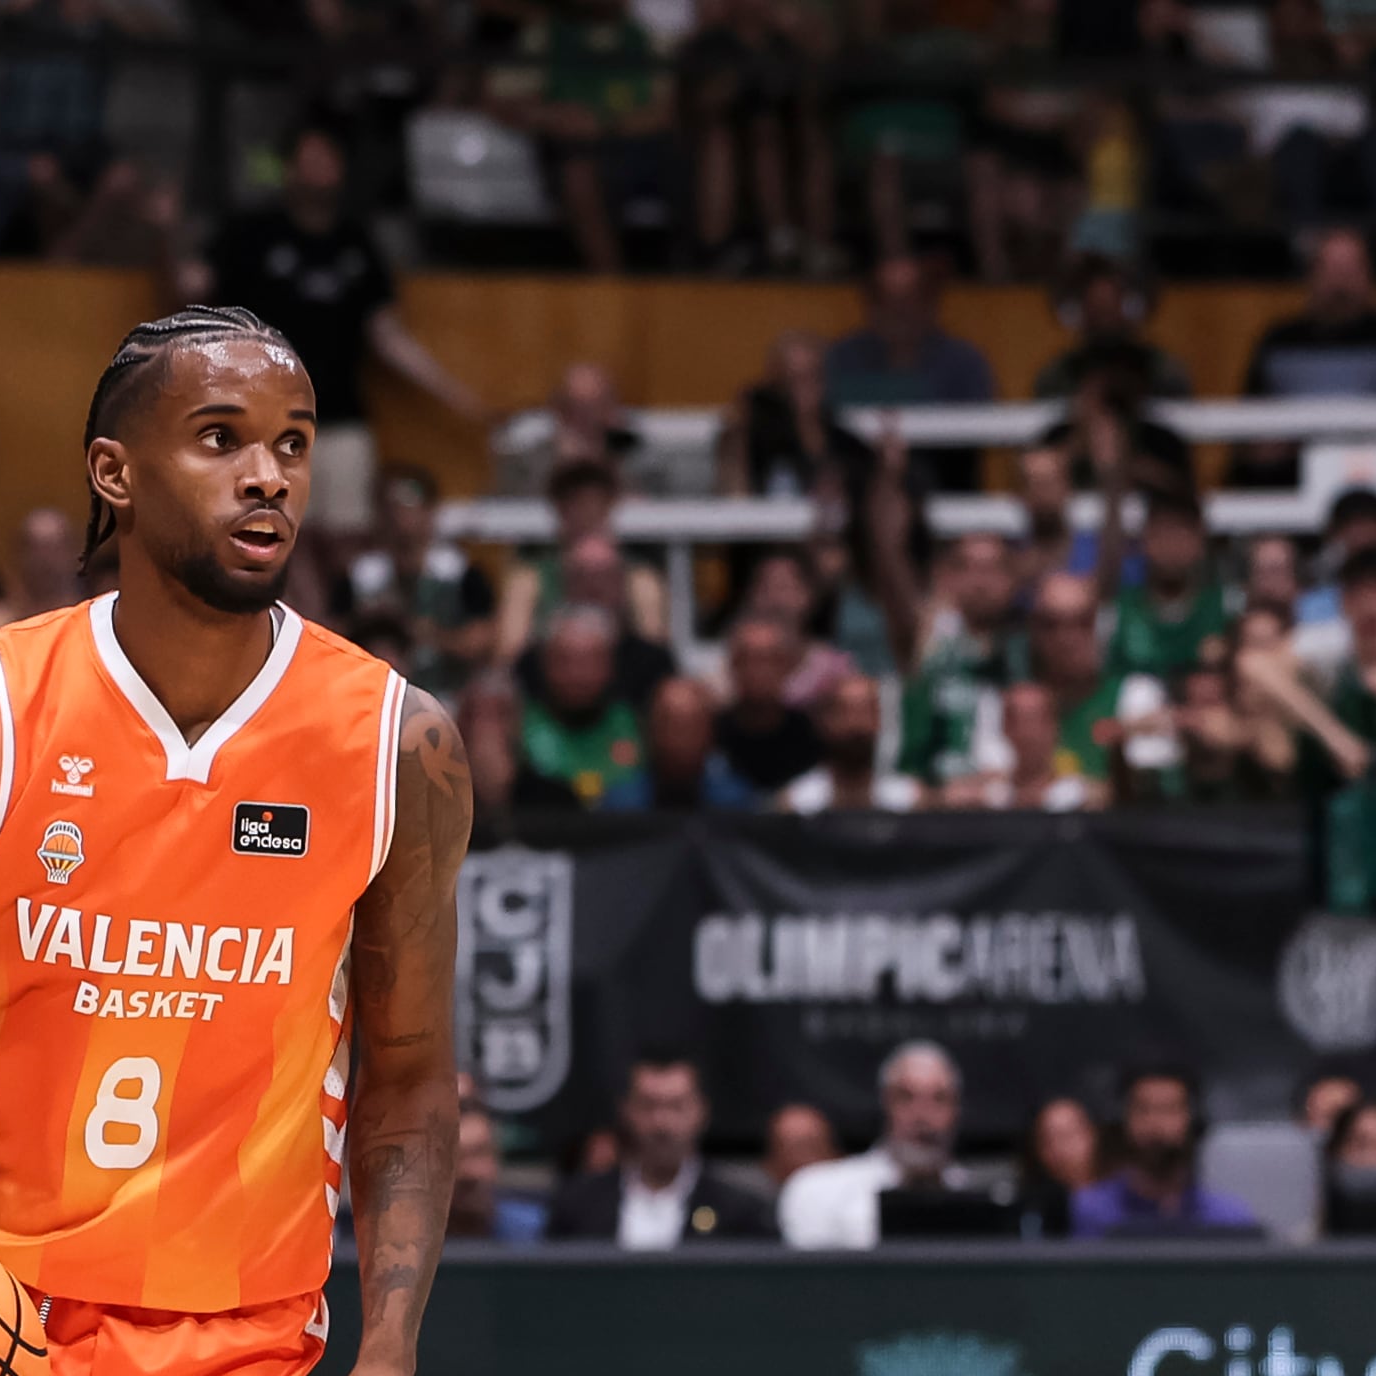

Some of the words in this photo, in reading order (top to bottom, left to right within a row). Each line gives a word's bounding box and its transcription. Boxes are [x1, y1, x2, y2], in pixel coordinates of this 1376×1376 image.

[50, 778, 94, 797] hummel
[240, 817, 269, 836] liga
[239, 833, 303, 851] endesa
[16, 896, 295, 985] VALENCIA
[72, 980, 224, 1022] BASKET
[84, 1056, 162, 1169] 8
